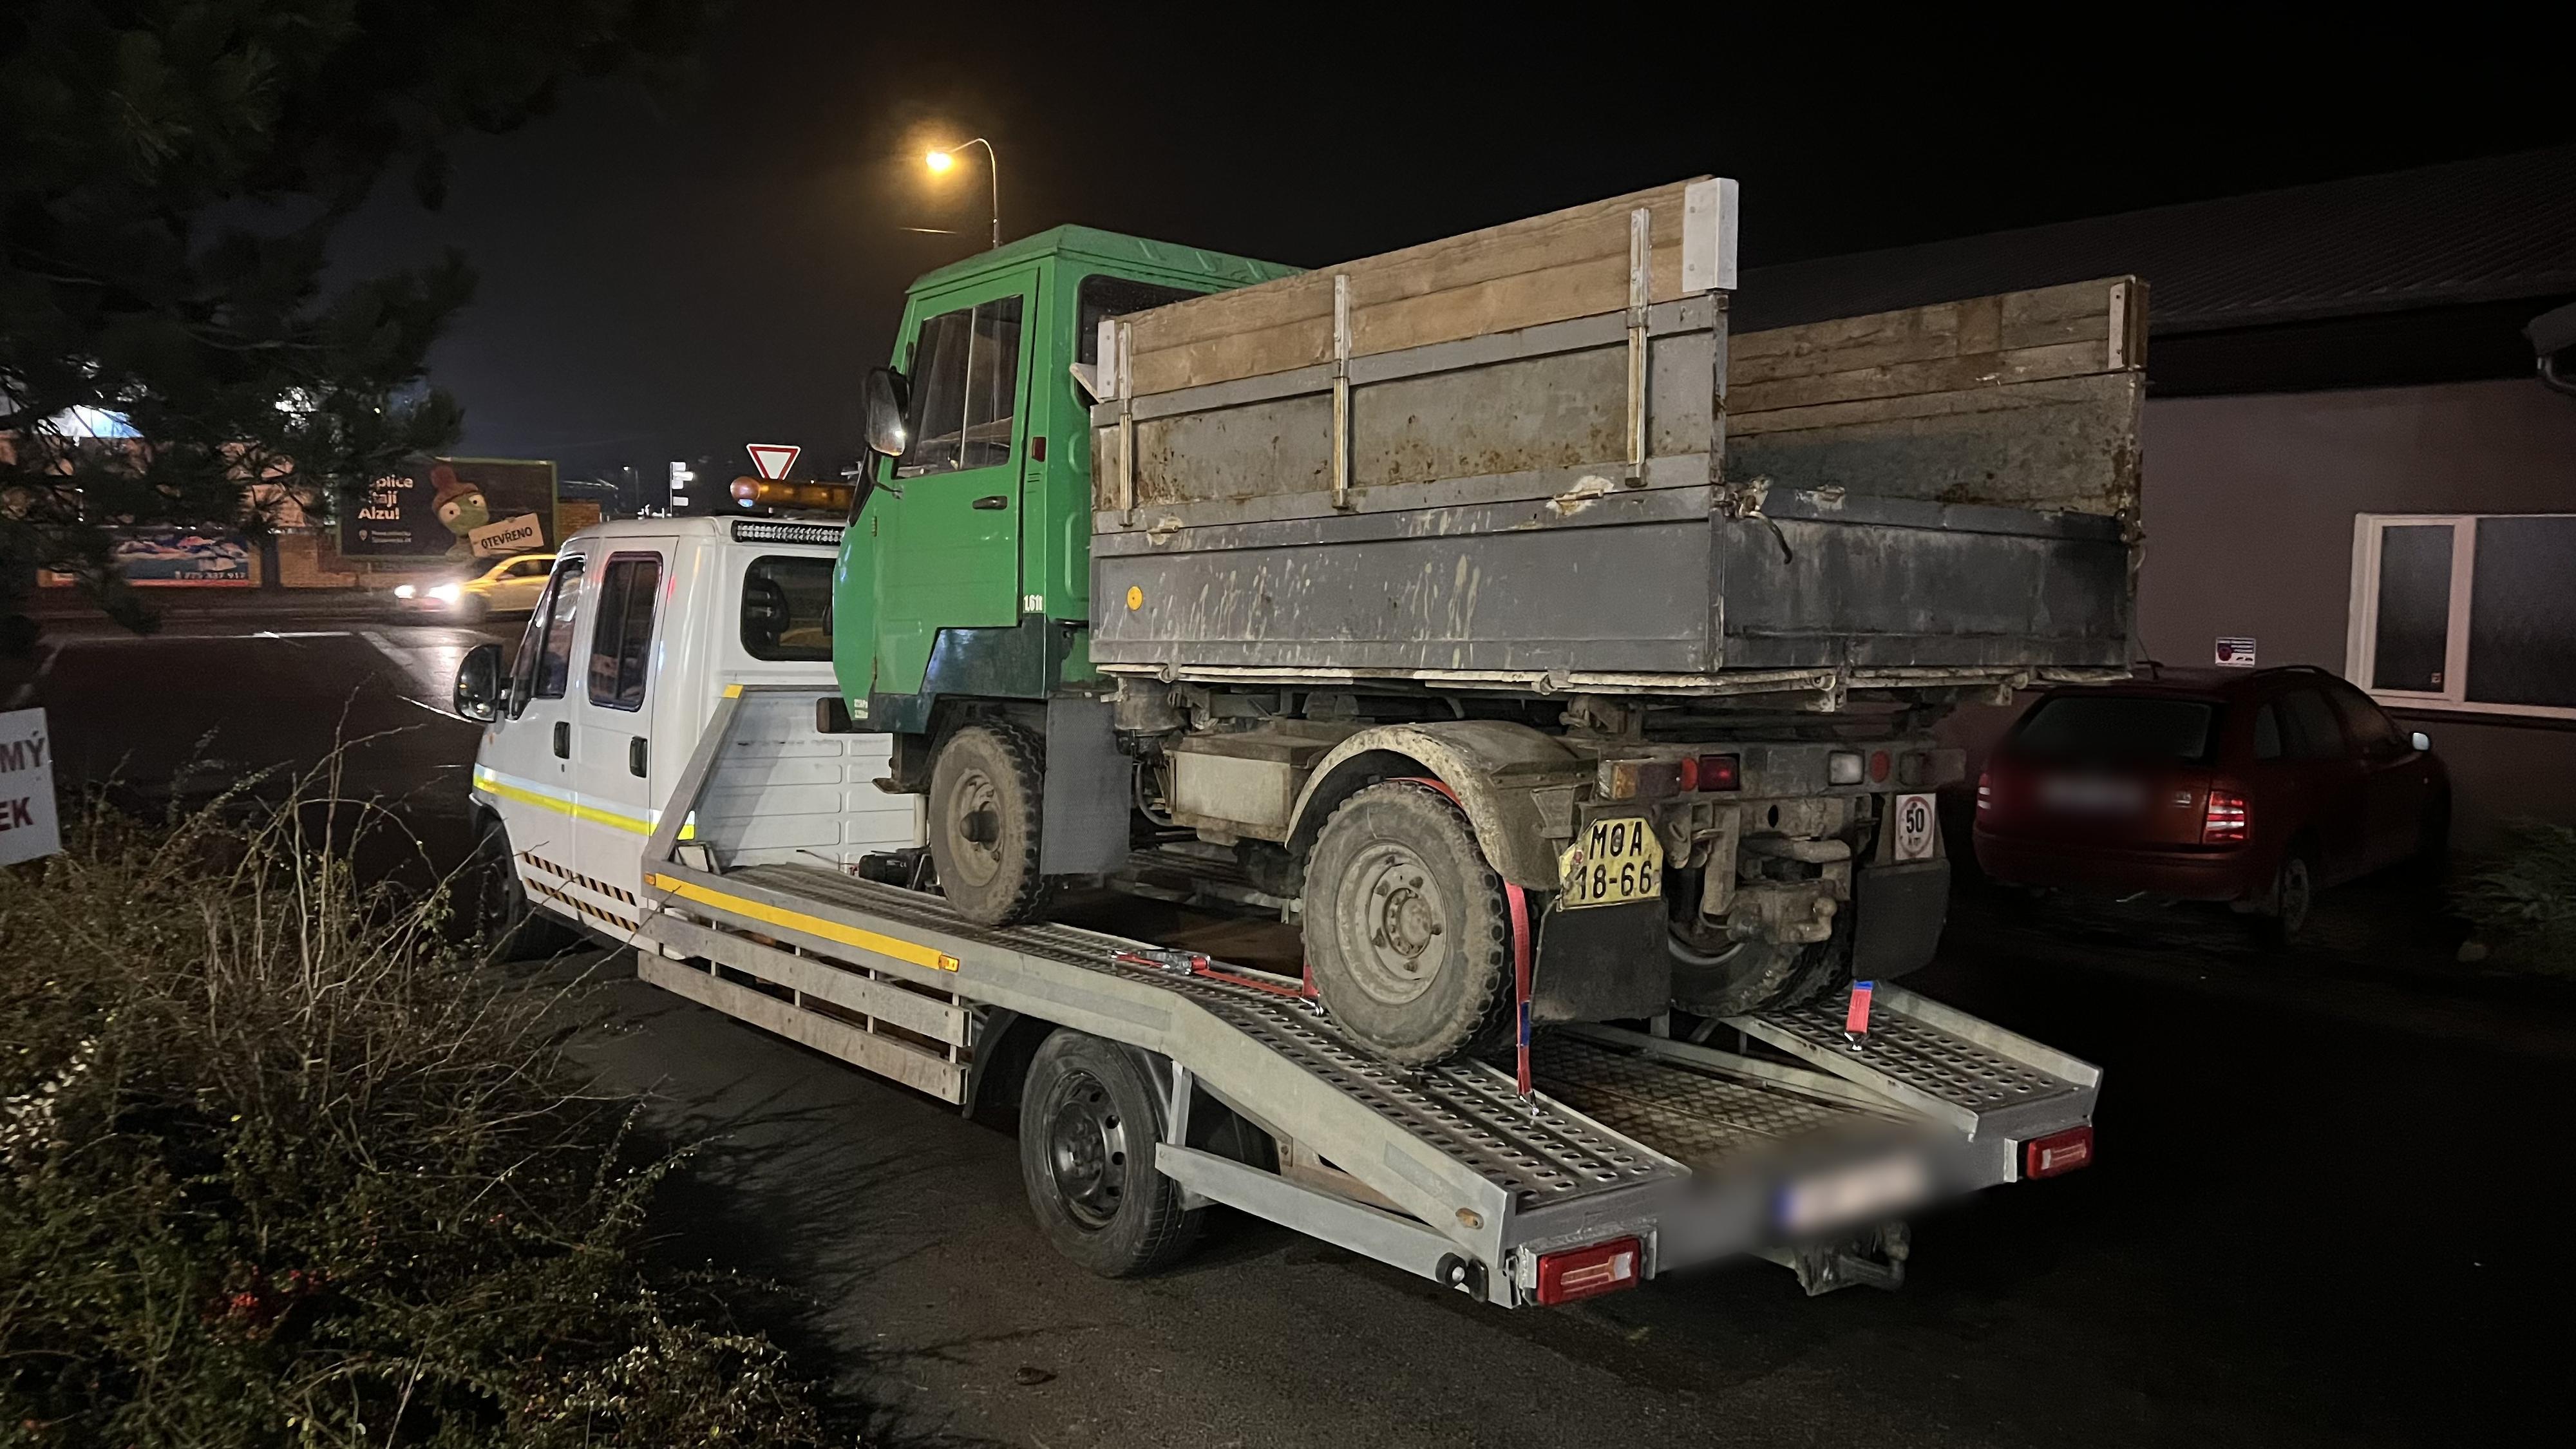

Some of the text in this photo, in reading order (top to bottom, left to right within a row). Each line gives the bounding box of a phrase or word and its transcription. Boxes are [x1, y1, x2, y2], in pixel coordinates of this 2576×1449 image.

[369, 474, 413, 489] plice
[358, 506, 399, 520] Alzu!
[480, 527, 533, 549] OTEVŘENO
[0, 730, 45, 773] MÝ
[1906, 808, 1924, 833] 50
[1589, 822, 1642, 860] MOA
[1575, 860, 1652, 899] 18-66
